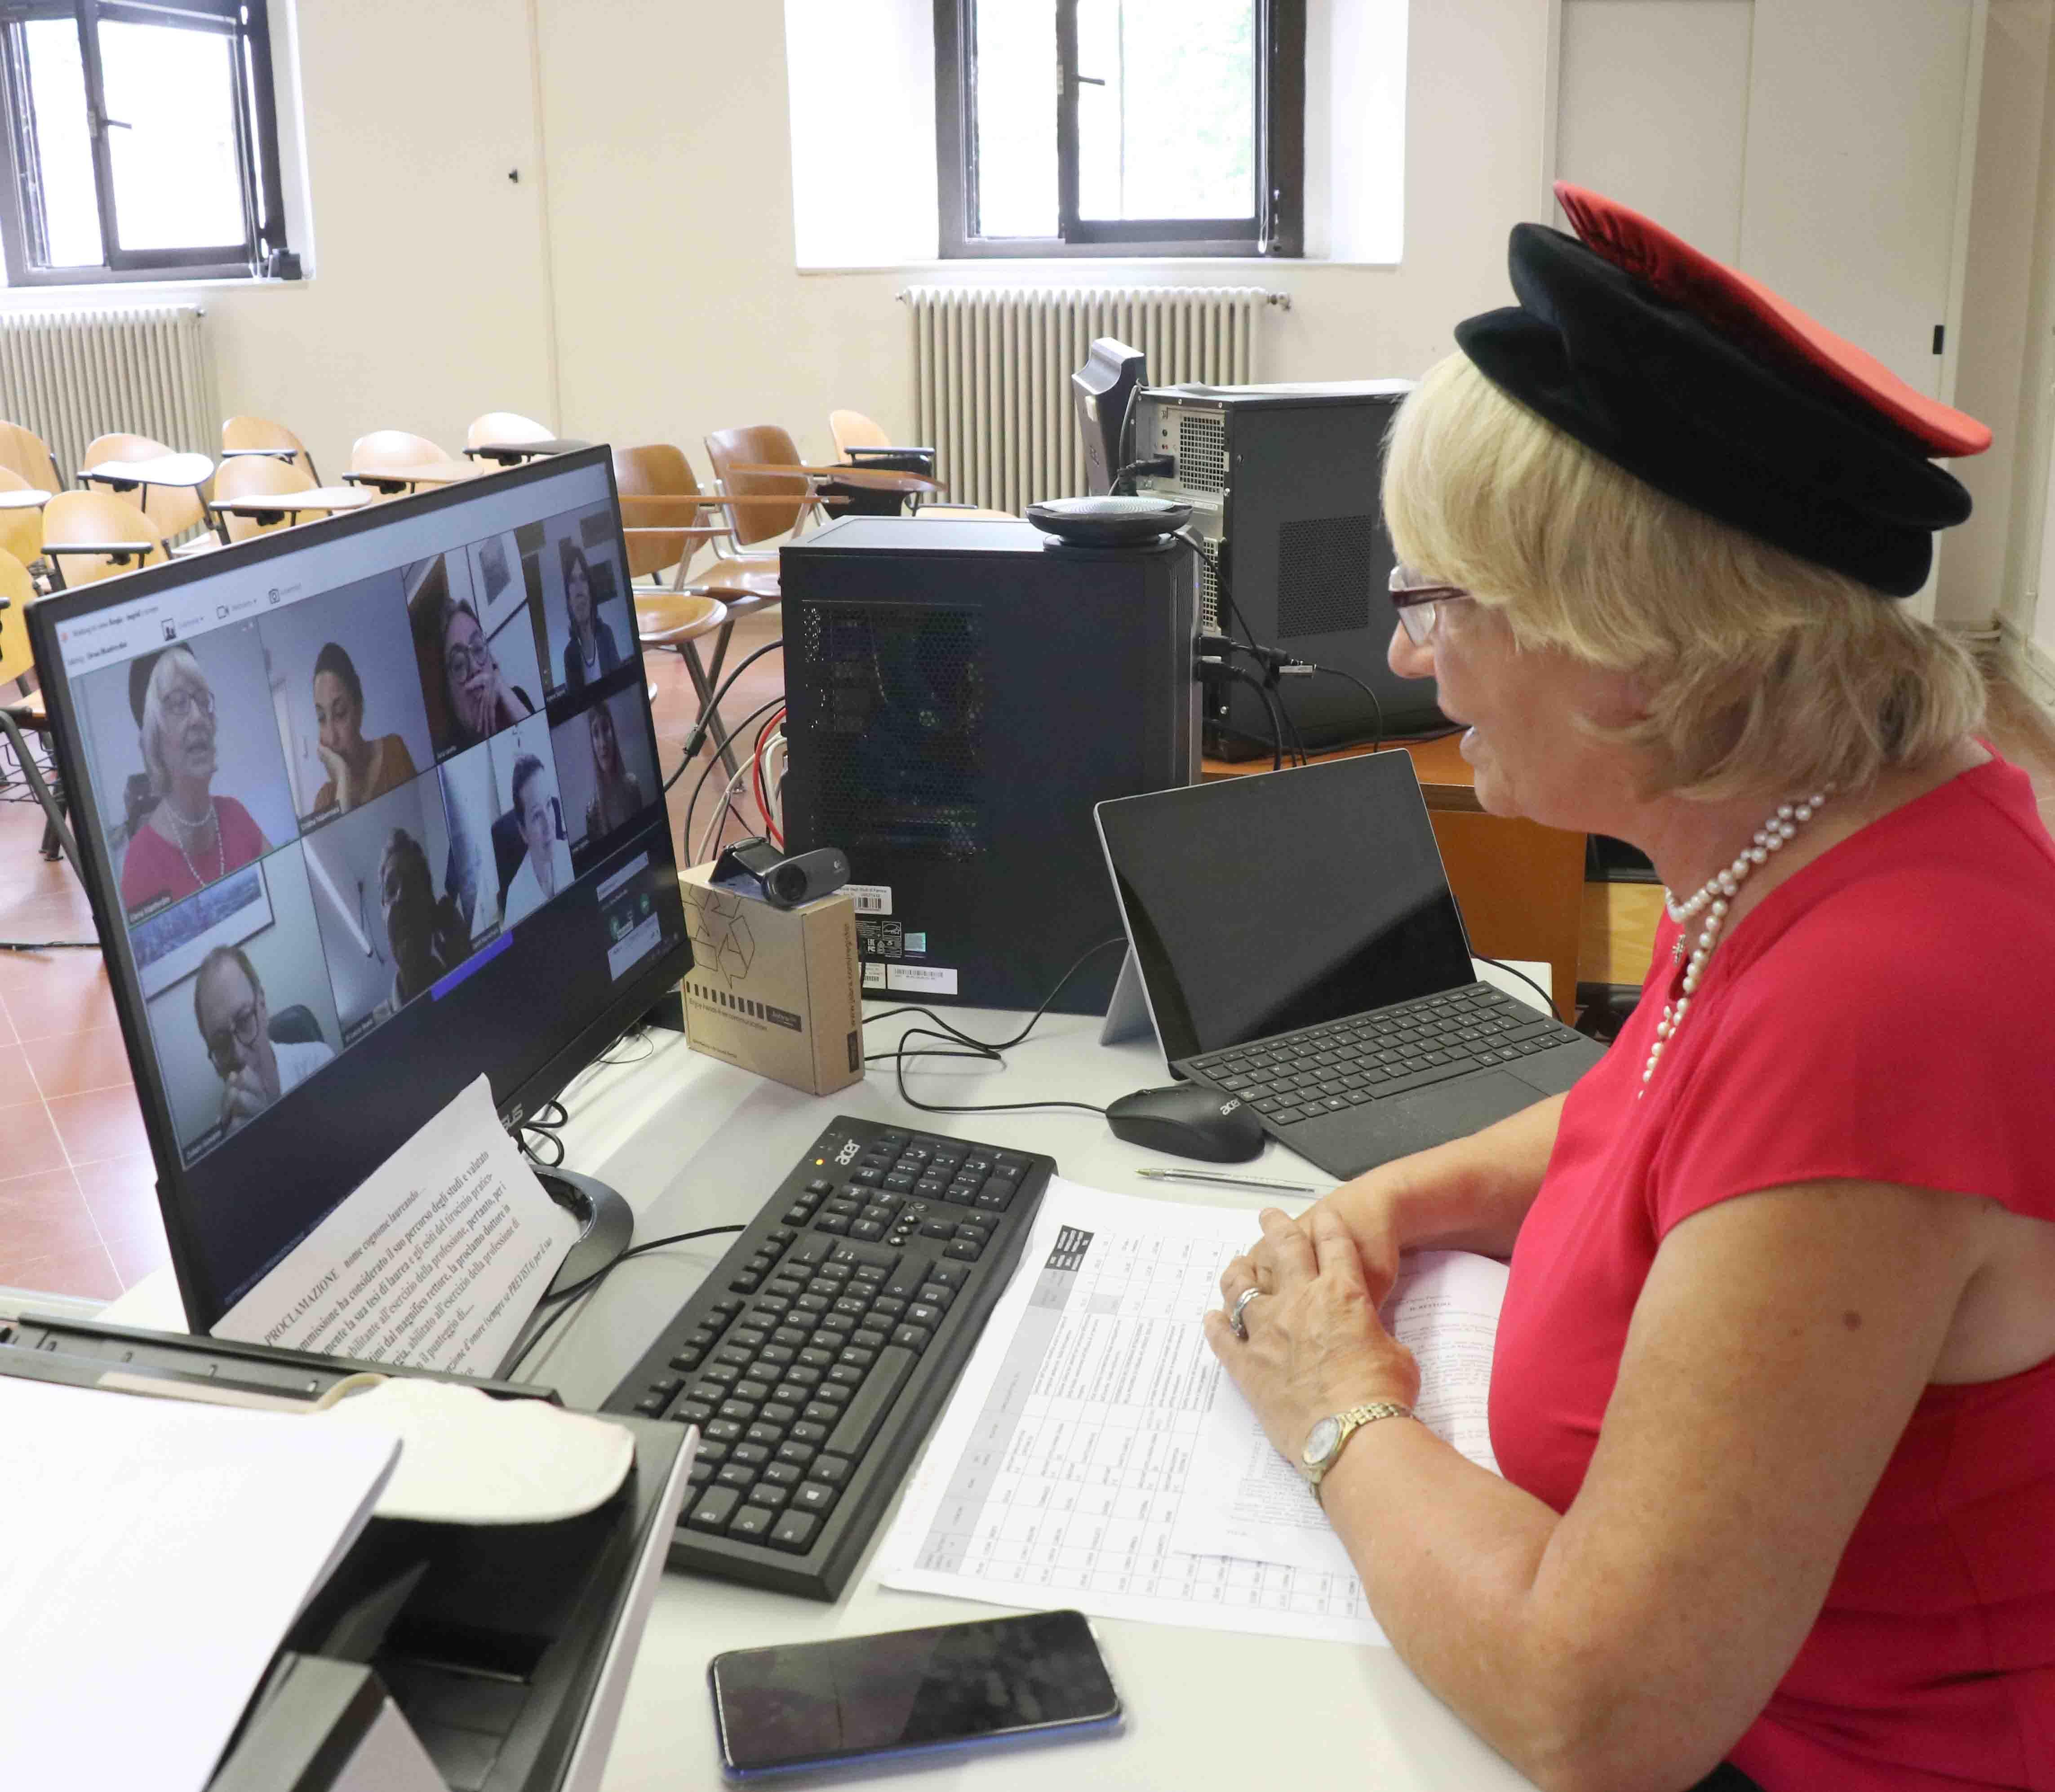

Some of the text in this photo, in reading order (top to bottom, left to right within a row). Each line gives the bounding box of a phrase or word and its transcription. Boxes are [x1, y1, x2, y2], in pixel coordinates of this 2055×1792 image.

[501, 1103, 523, 1130] SUS
[834, 1139, 860, 1165] acer
[264, 1268, 340, 1347] PROCLAMAZIONE
[343, 1246, 364, 1269] nome
[362, 1219, 391, 1251] cognome
[335, 1297, 350, 1311] ha
[348, 1256, 389, 1300] considerato
[404, 1209, 433, 1244] percorso
[431, 1190, 449, 1213] degli
[446, 1175, 464, 1198] studi
[466, 1151, 489, 1177] valutato
[343, 1319, 356, 1331] la
[354, 1305, 369, 1322] sua
[366, 1289, 382, 1309] tesi
[384, 1261, 410, 1287] laurea
[413, 1243, 424, 1262] gli
[422, 1229, 438, 1250] esiti
[435, 1217, 448, 1236] del
[444, 1194, 473, 1225] tirocinio
[383, 1329, 398, 1348] dal
[395, 1297, 428, 1336] magnifico
[446, 1261, 459, 1278] la
[455, 1233, 486, 1269] proclamo
[482, 1205, 506, 1236] dottore
[408, 1313, 436, 1350] abilitato
[467, 1260, 486, 1280] della
[481, 1225, 515, 1266] professione
[347, 1322, 381, 1358] bilitante
[415, 1263, 434, 1284] della
[426, 1318, 459, 1360] punteggio
